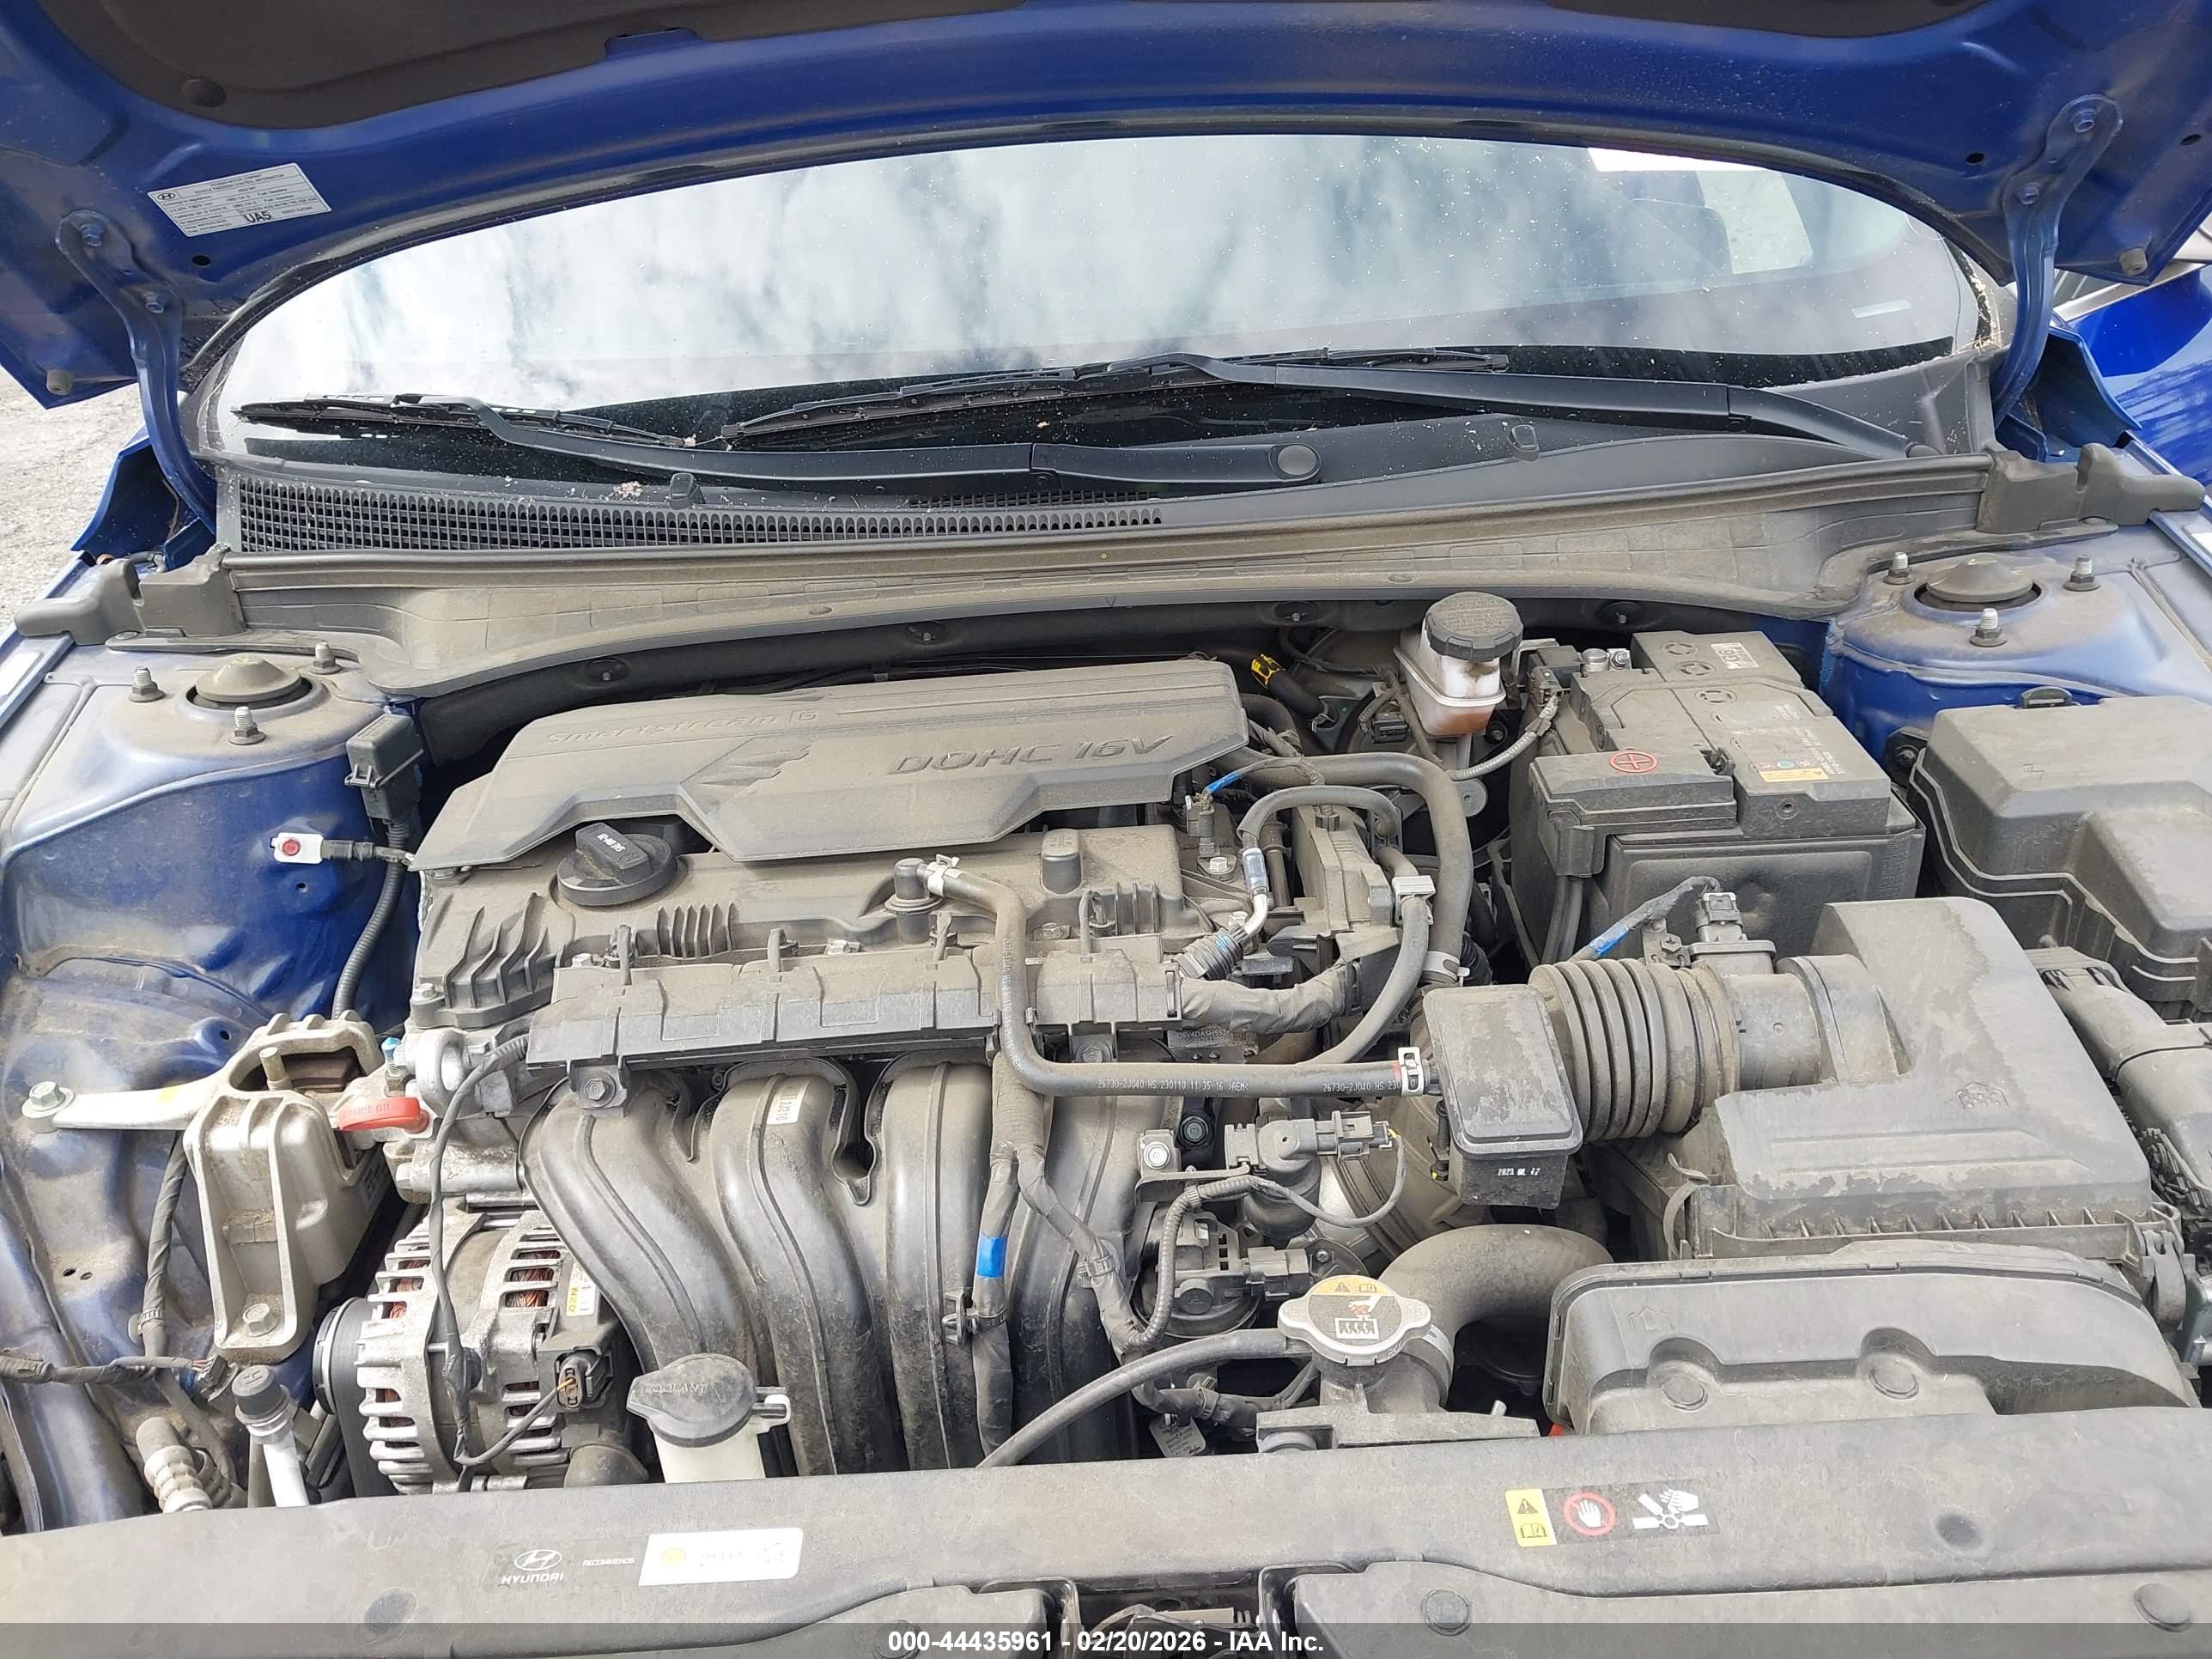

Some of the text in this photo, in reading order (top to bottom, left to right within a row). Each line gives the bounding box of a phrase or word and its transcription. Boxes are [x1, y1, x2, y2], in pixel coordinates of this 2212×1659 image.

[243, 210, 272, 223] UA5
[887, 735, 1175, 775] DOHC 16V
[1098, 1079, 1145, 1089] 26730-2J040
[1147, 1079, 1158, 1090] HS
[1160, 1079, 1187, 1091] 230110
[1322, 1081, 1371, 1092] 26730-2J040
[1375, 1081, 1384, 1091] HS
[645, 1383, 708, 1395] COOLANT
[501, 1557, 635, 1585] HYUNDAI RECOMMENDS
